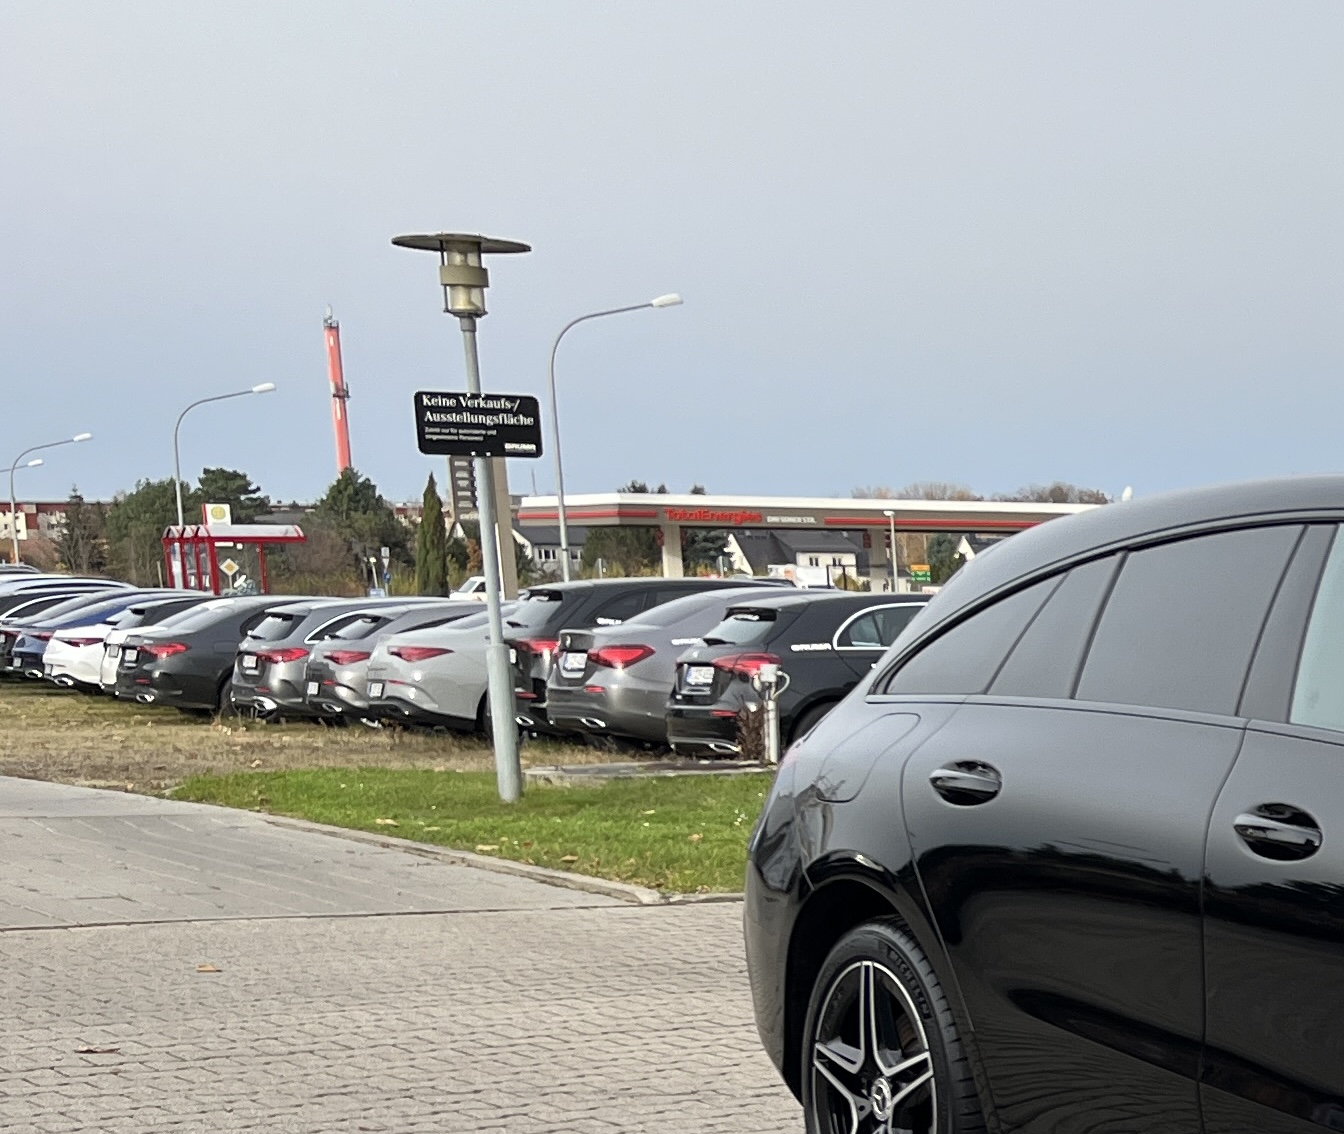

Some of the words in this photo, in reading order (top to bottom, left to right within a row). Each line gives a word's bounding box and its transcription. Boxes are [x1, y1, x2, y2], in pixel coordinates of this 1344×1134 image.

[422, 394, 457, 408] Keine
[424, 410, 535, 427] Ausstellungsfläche
[665, 507, 762, 525] TotalEnergies
